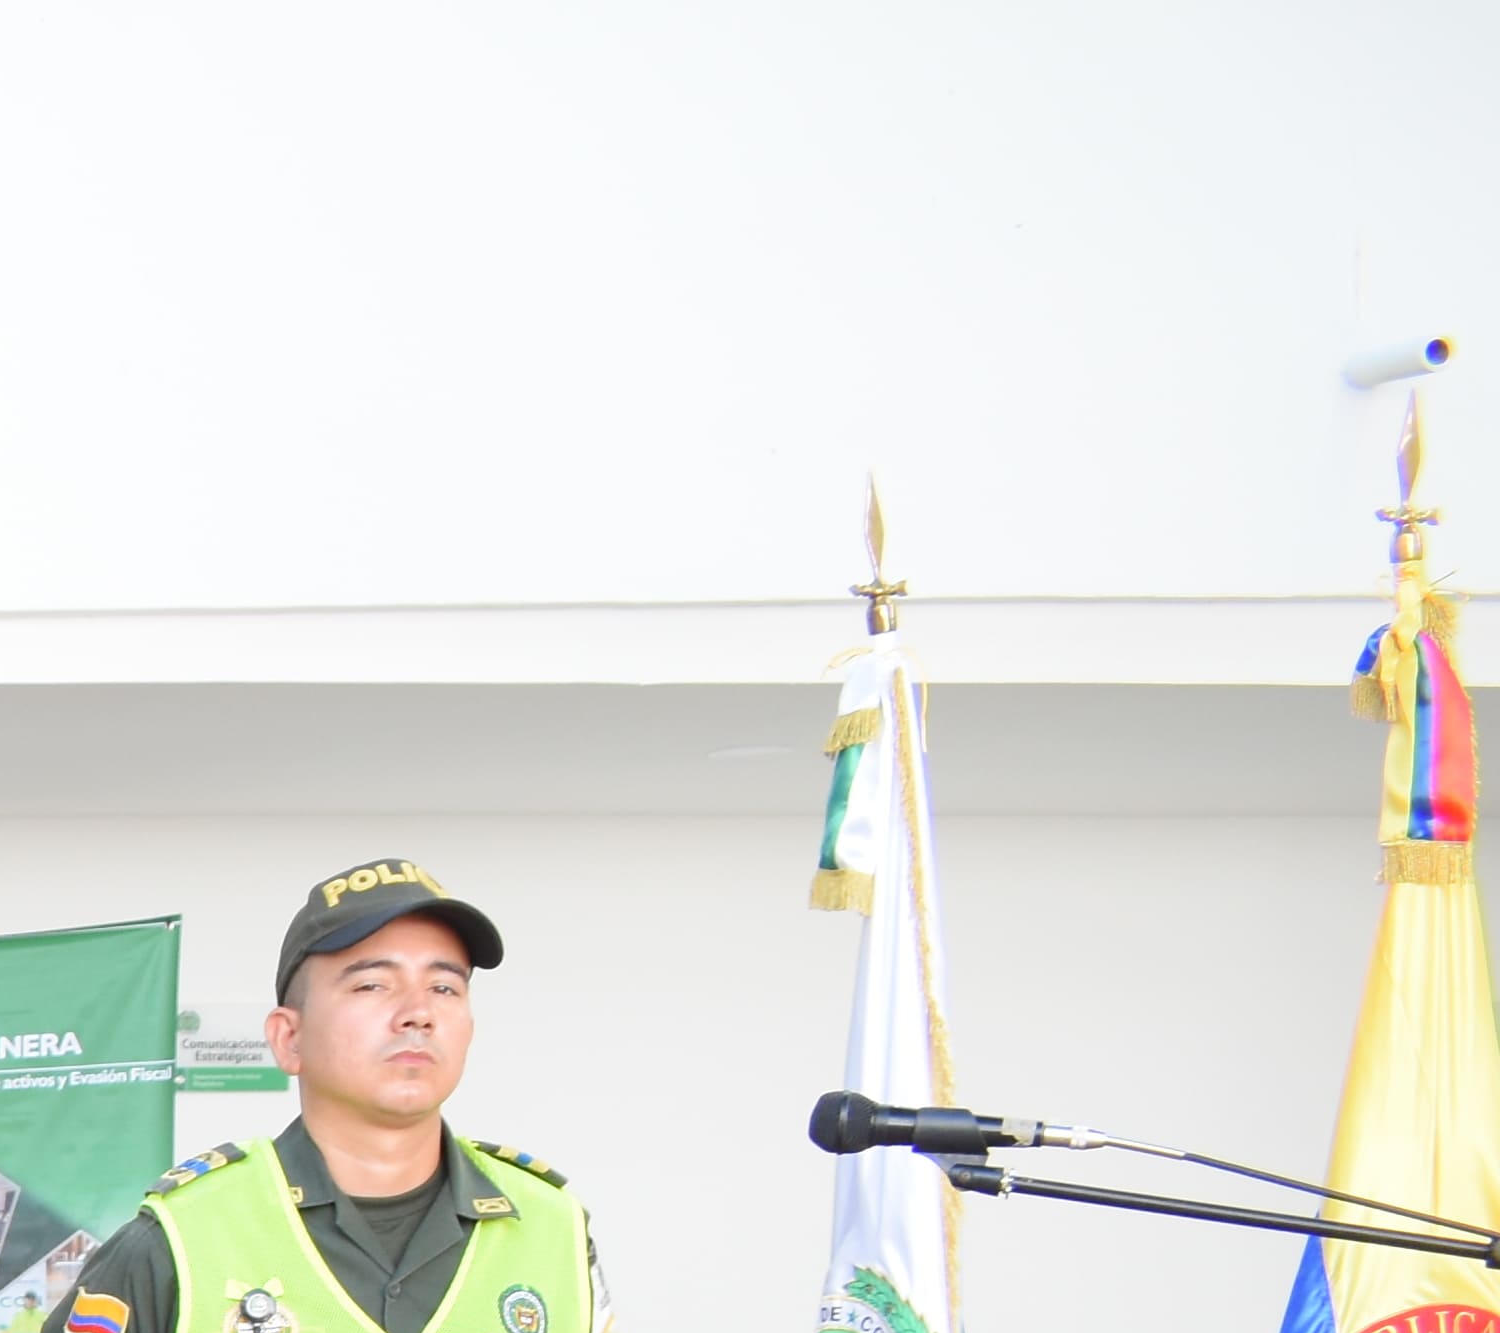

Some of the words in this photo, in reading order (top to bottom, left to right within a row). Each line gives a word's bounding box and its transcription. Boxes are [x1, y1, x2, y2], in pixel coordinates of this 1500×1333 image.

[182, 1037, 269, 1049] Comunicacione
[3, 1073, 55, 1091] activos
[57, 1074, 67, 1091] y
[69, 1067, 127, 1086] Evasión
[130, 1065, 173, 1082] Fiscal
[819, 1306, 842, 1322] DE
